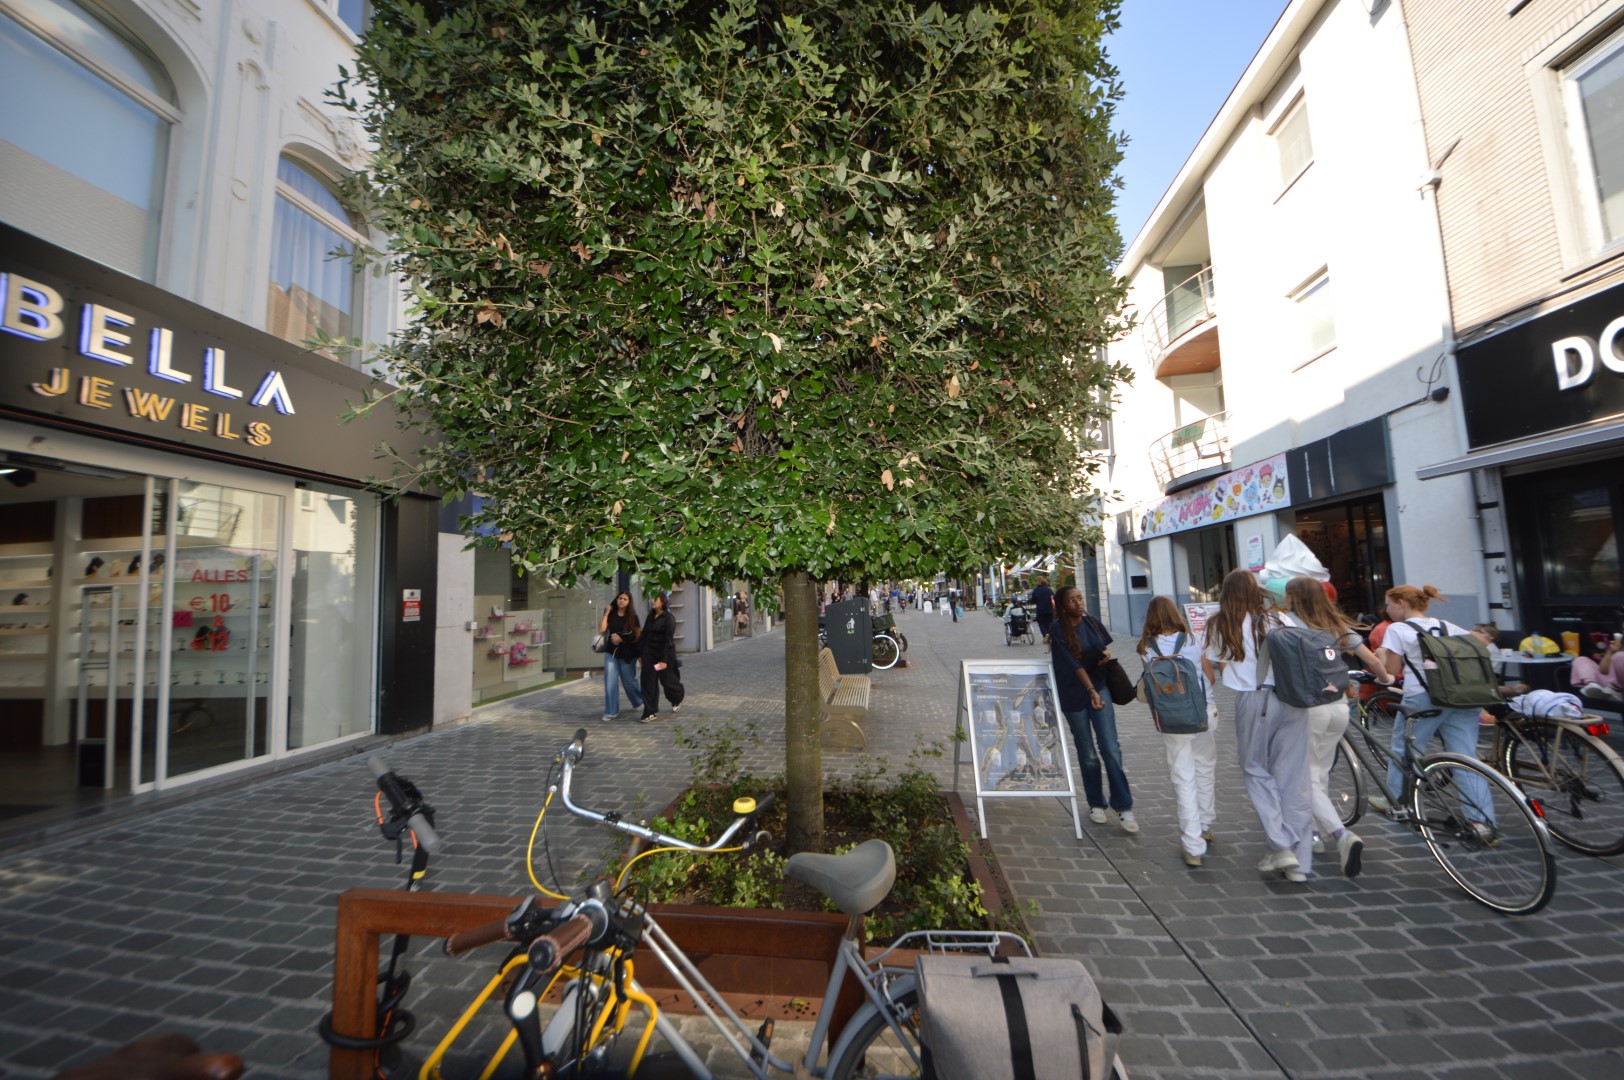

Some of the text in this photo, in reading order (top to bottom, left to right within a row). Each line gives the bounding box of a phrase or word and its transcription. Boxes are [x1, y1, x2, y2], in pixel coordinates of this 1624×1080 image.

[0, 272, 295, 416] BELLA
[31, 368, 272, 446] JEWELS
[192, 569, 248, 583] ALLES
